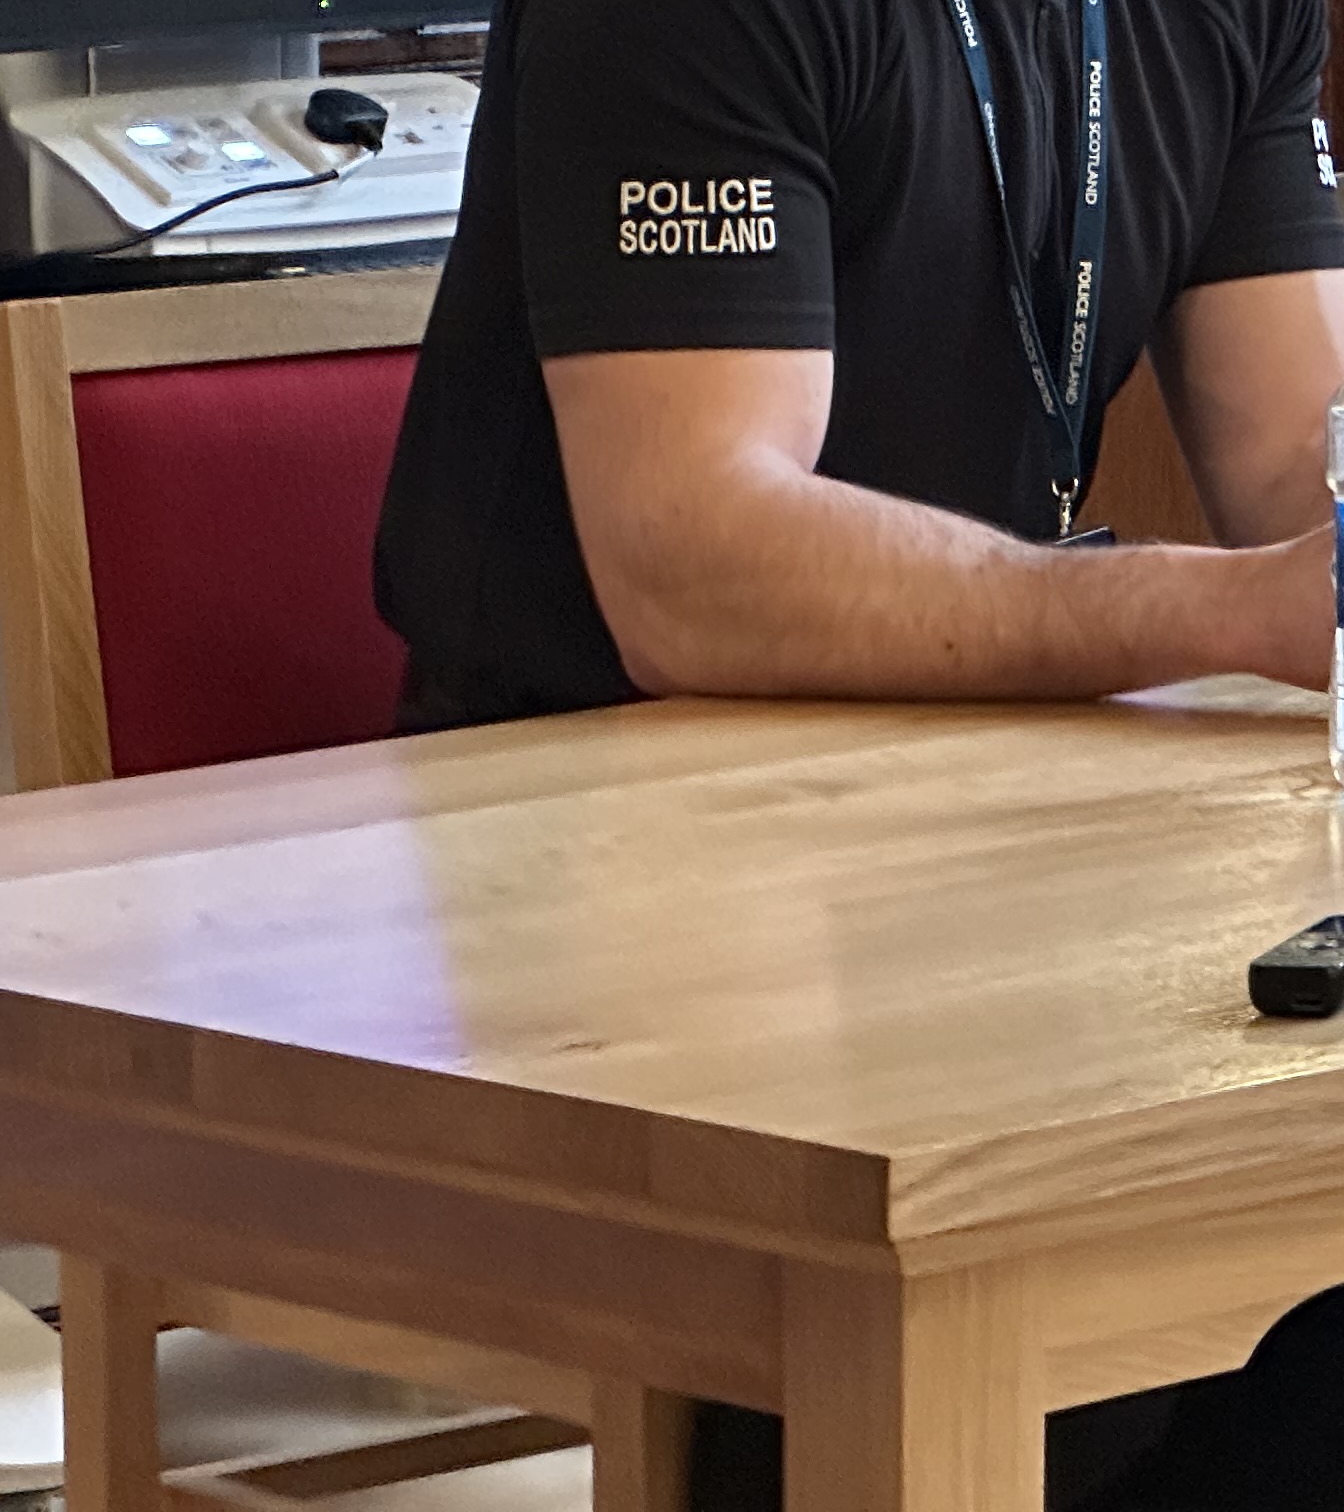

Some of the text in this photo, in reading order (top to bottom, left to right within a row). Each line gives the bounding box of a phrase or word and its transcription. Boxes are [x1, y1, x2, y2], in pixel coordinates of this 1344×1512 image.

[1084, 60, 1102, 206] POLICE SCOTLAND
[620, 178, 775, 216] POLICE
[618, 215, 777, 256] SCOTLAND
[1075, 260, 1093, 319] POLICE
